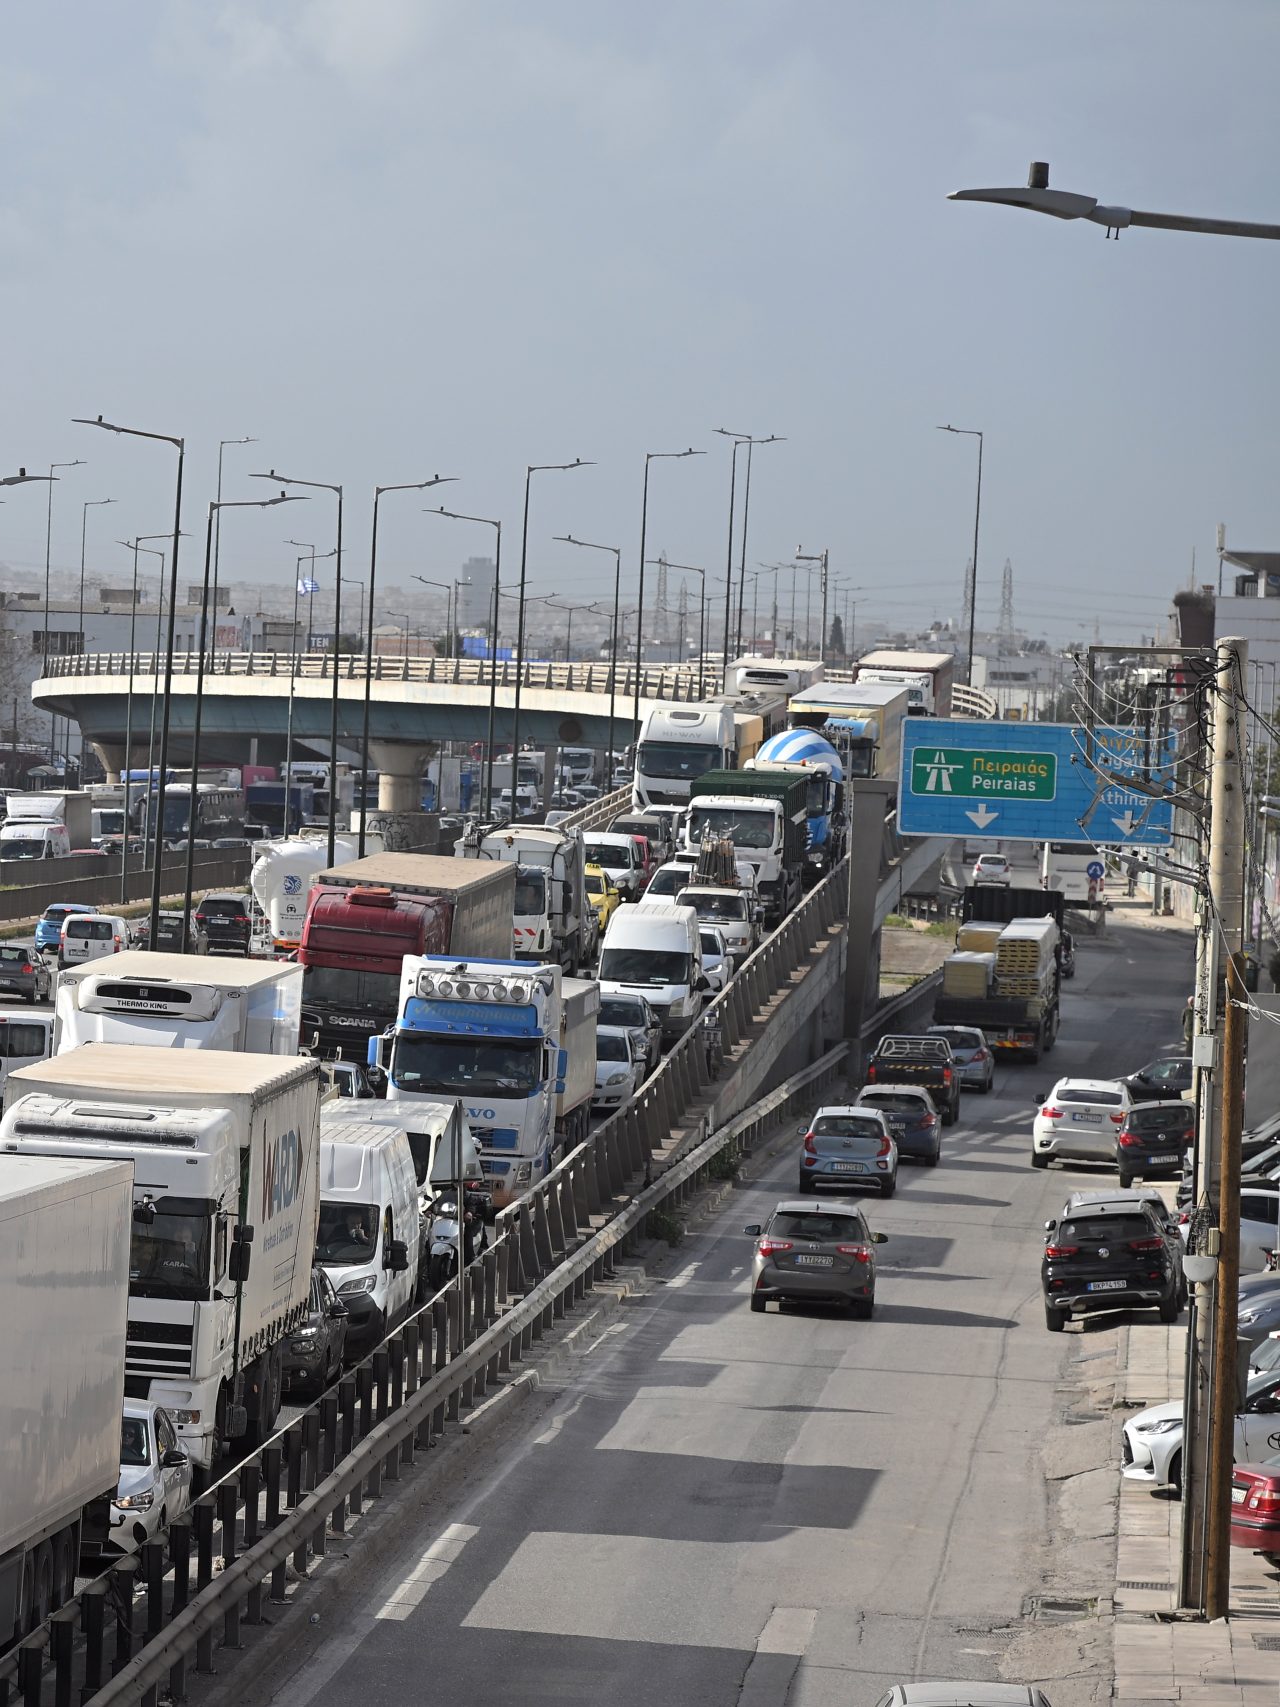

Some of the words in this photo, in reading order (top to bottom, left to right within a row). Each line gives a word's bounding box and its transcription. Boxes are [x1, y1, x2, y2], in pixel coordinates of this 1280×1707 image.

[662, 730, 703, 739] HI-WAY
[973, 758, 1047, 777] Πειραιάς
[972, 775, 1037, 791] Peiraias
[117, 1000, 149, 1009] THERMO
[328, 1015, 377, 1028] SCANIA
[466, 1108, 496, 1120] VO
